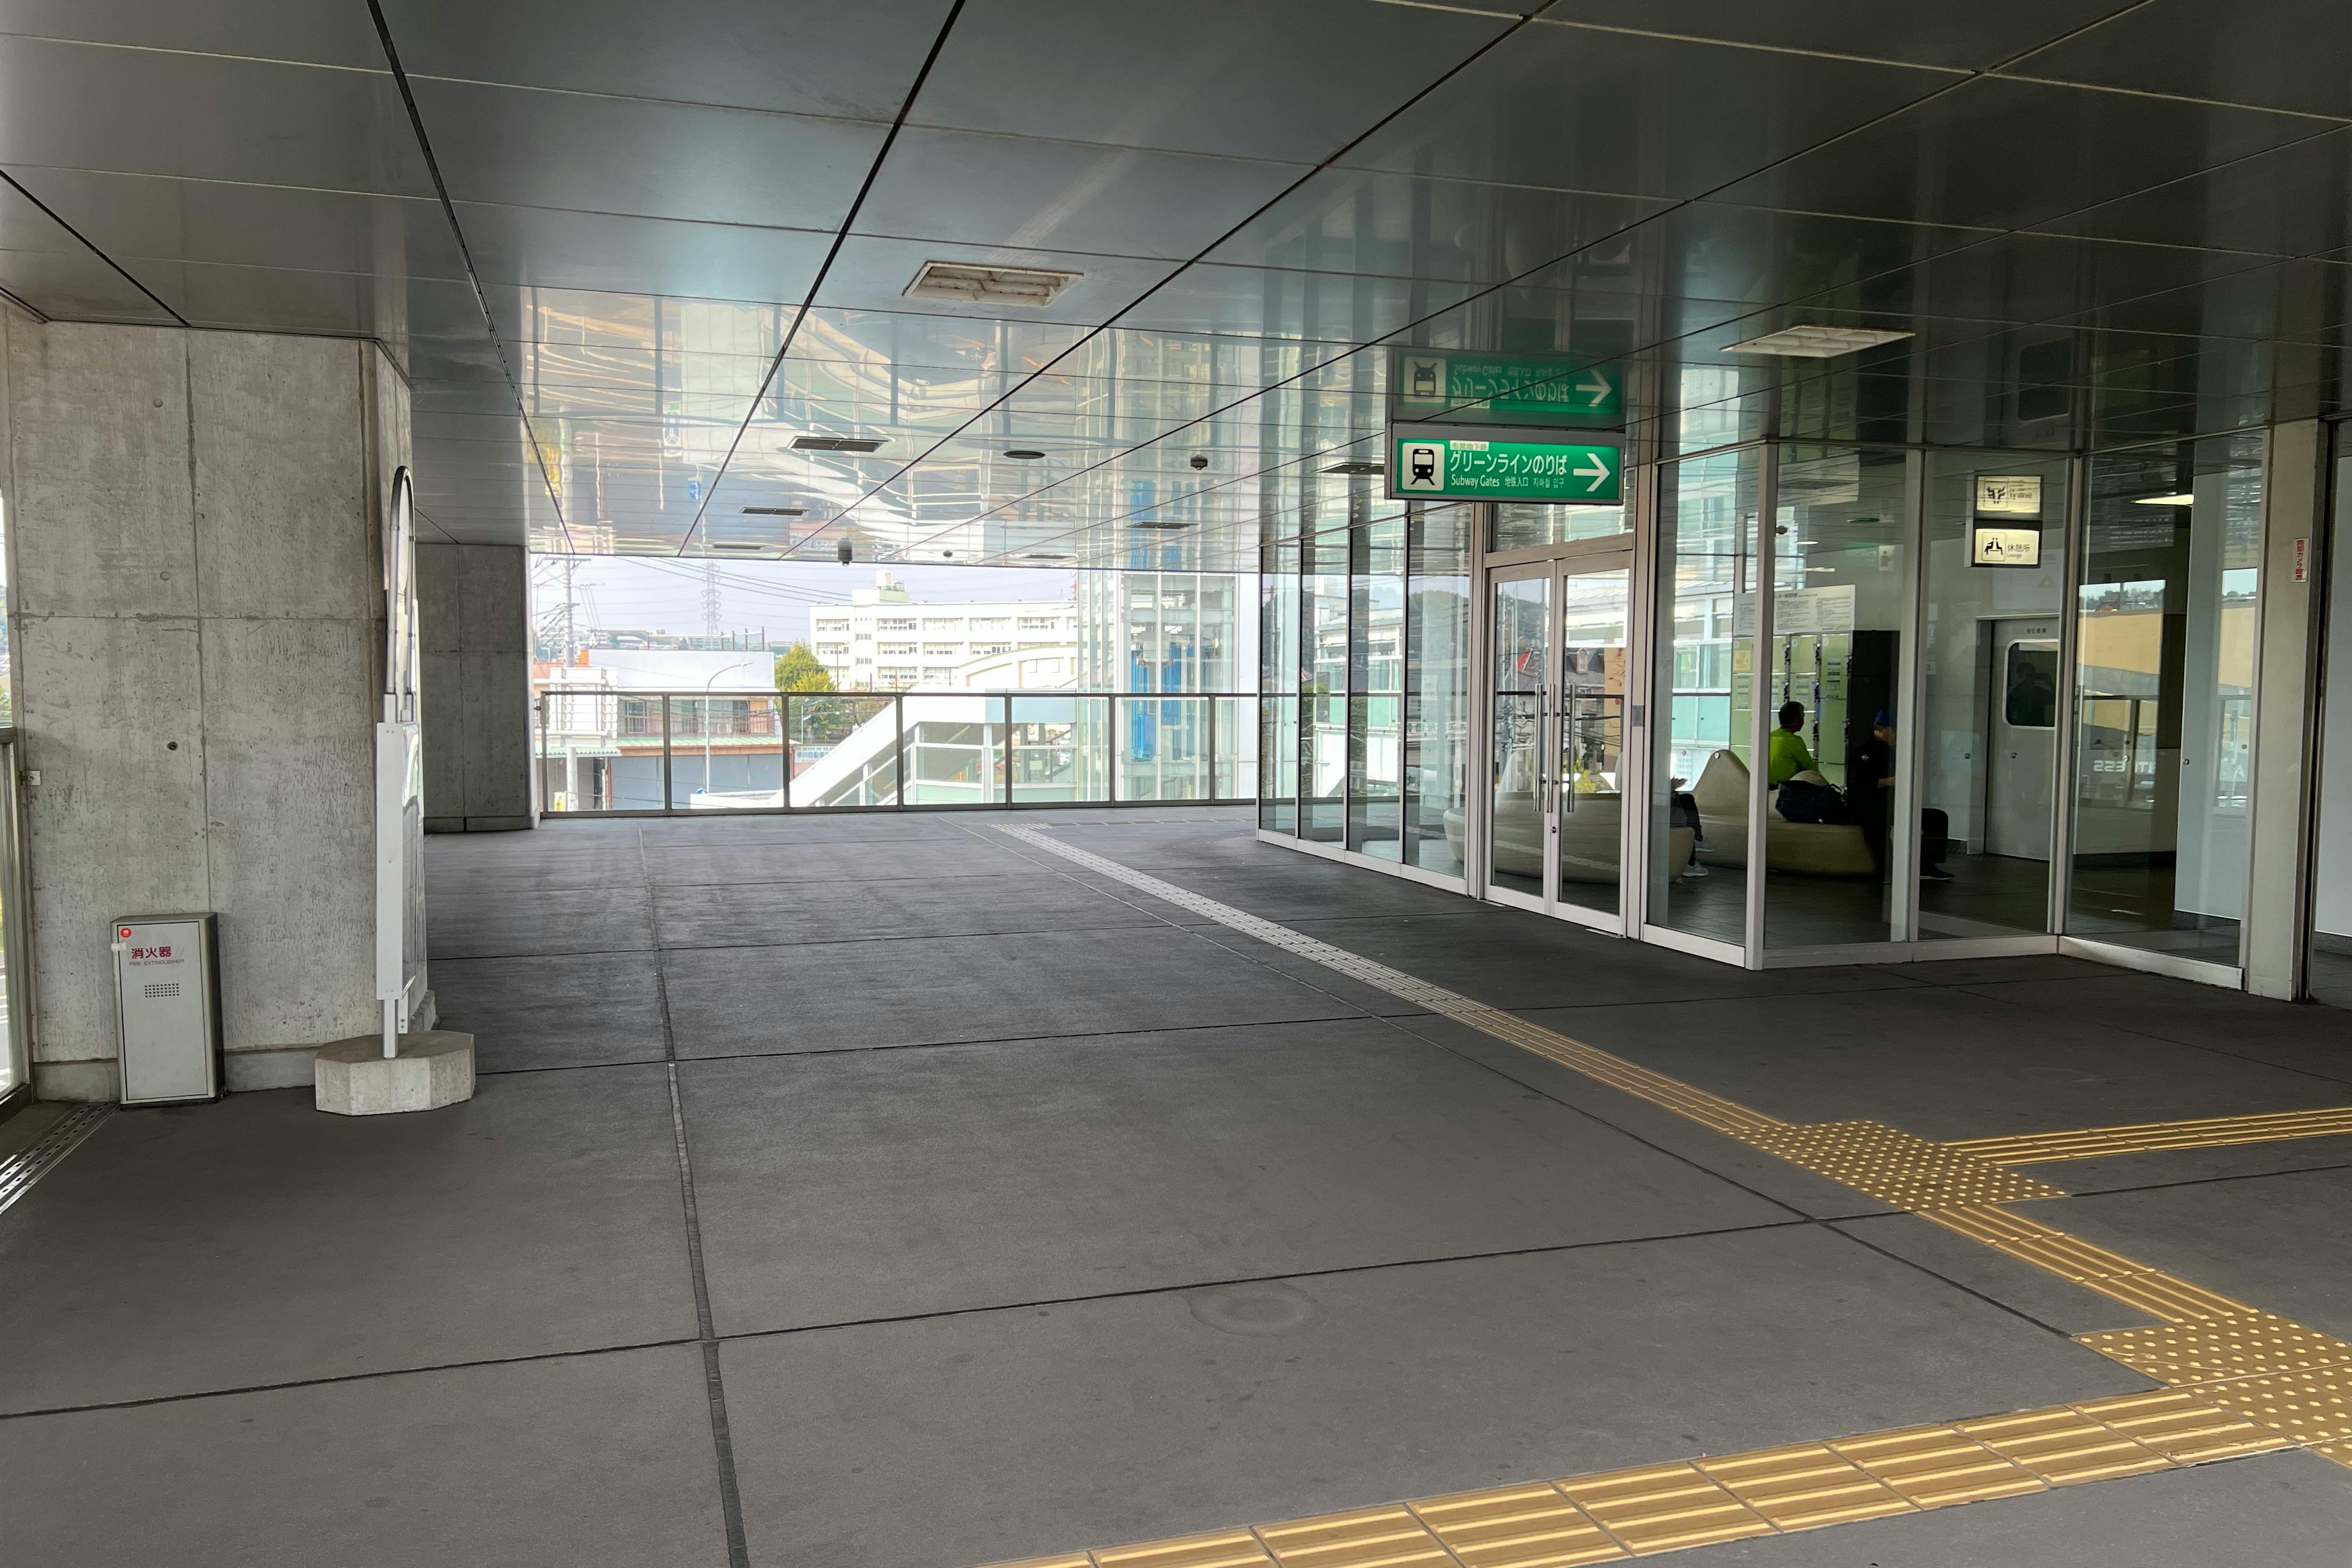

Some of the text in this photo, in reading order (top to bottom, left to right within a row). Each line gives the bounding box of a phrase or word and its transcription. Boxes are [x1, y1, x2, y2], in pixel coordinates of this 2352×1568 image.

[1450, 451, 1567, 475] グリーンラインのりば
[1451, 474, 1500, 489] Subway Gates
[131, 946, 172, 959] 消火器
